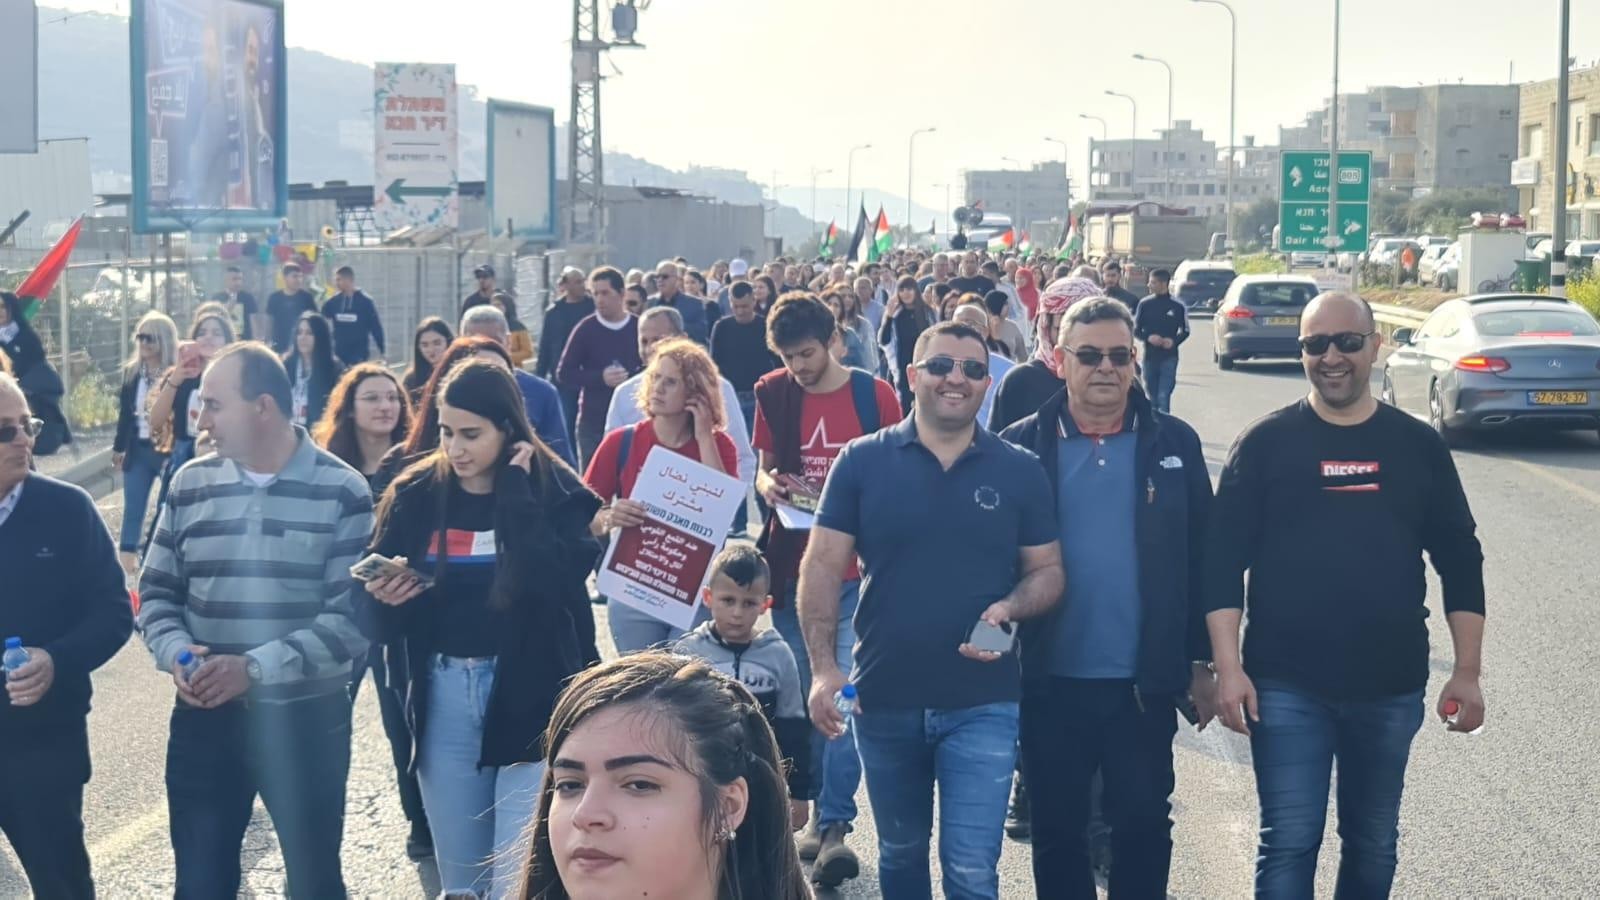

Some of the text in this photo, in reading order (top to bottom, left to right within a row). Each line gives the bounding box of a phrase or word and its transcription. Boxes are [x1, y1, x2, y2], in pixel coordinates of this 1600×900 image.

[659, 467, 724, 498] لنبني نضال
[663, 492, 702, 512] مشترك
